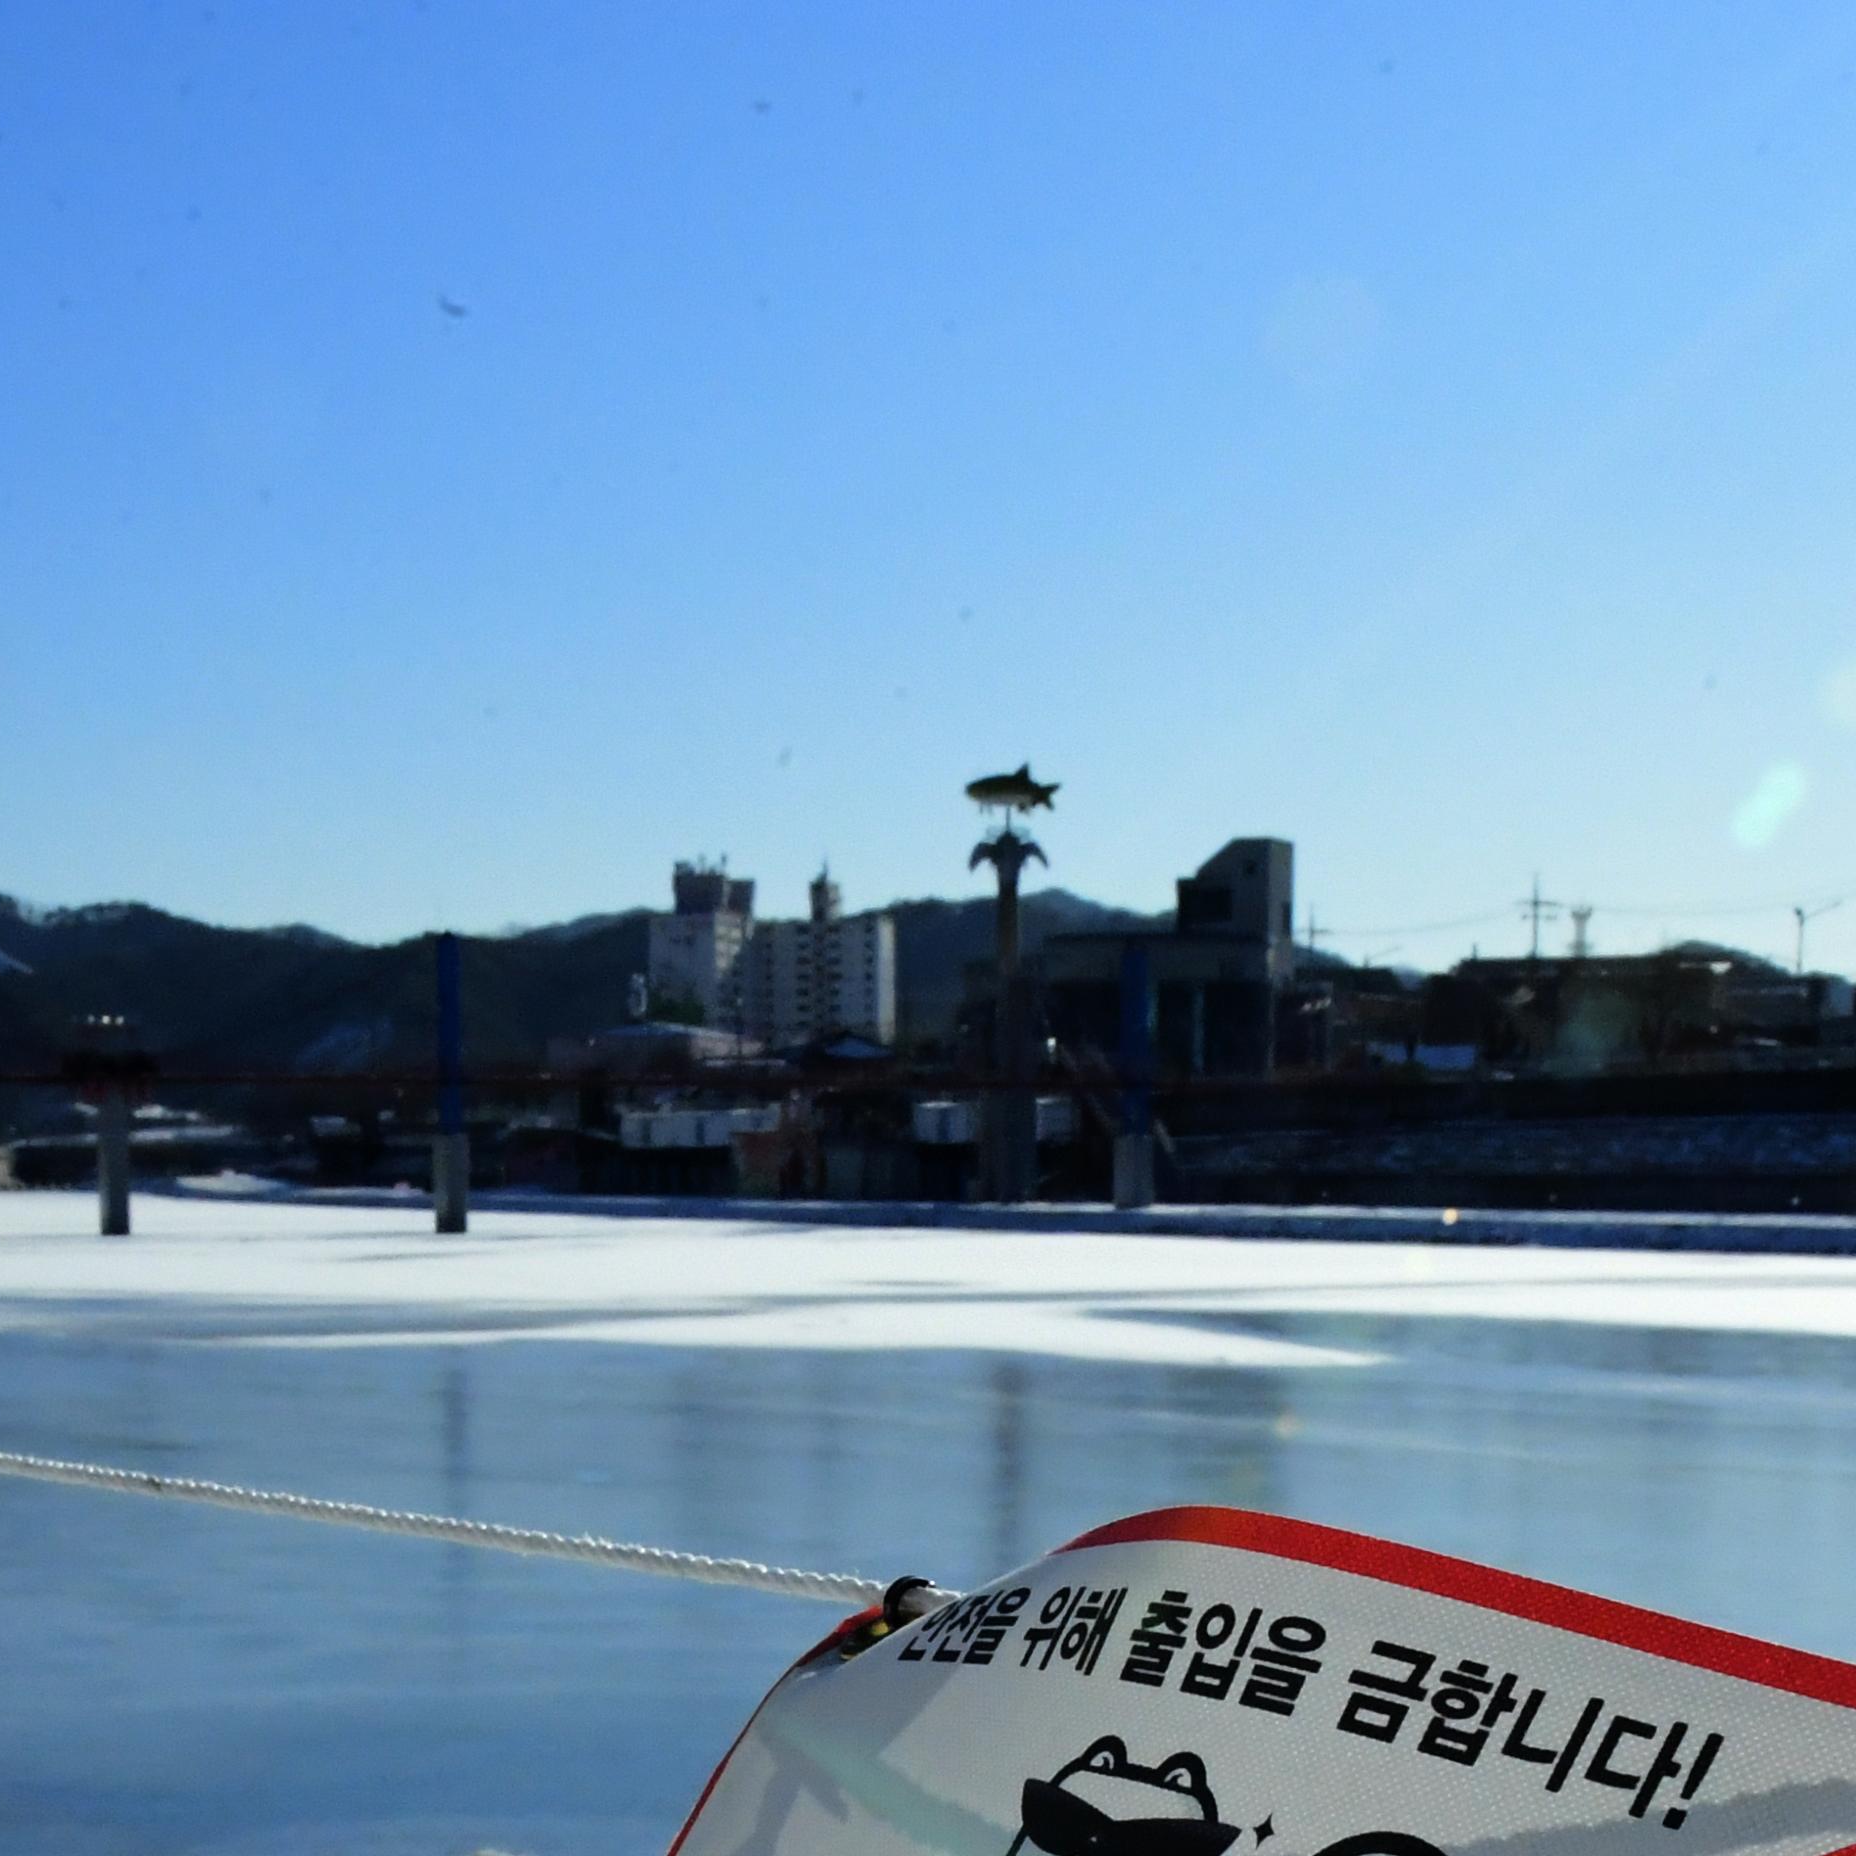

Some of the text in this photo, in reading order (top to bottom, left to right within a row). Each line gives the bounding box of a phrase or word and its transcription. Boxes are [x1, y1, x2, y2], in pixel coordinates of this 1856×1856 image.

[897, 1586, 1723, 1831] 안전을 위해 출입을 금합니다!
